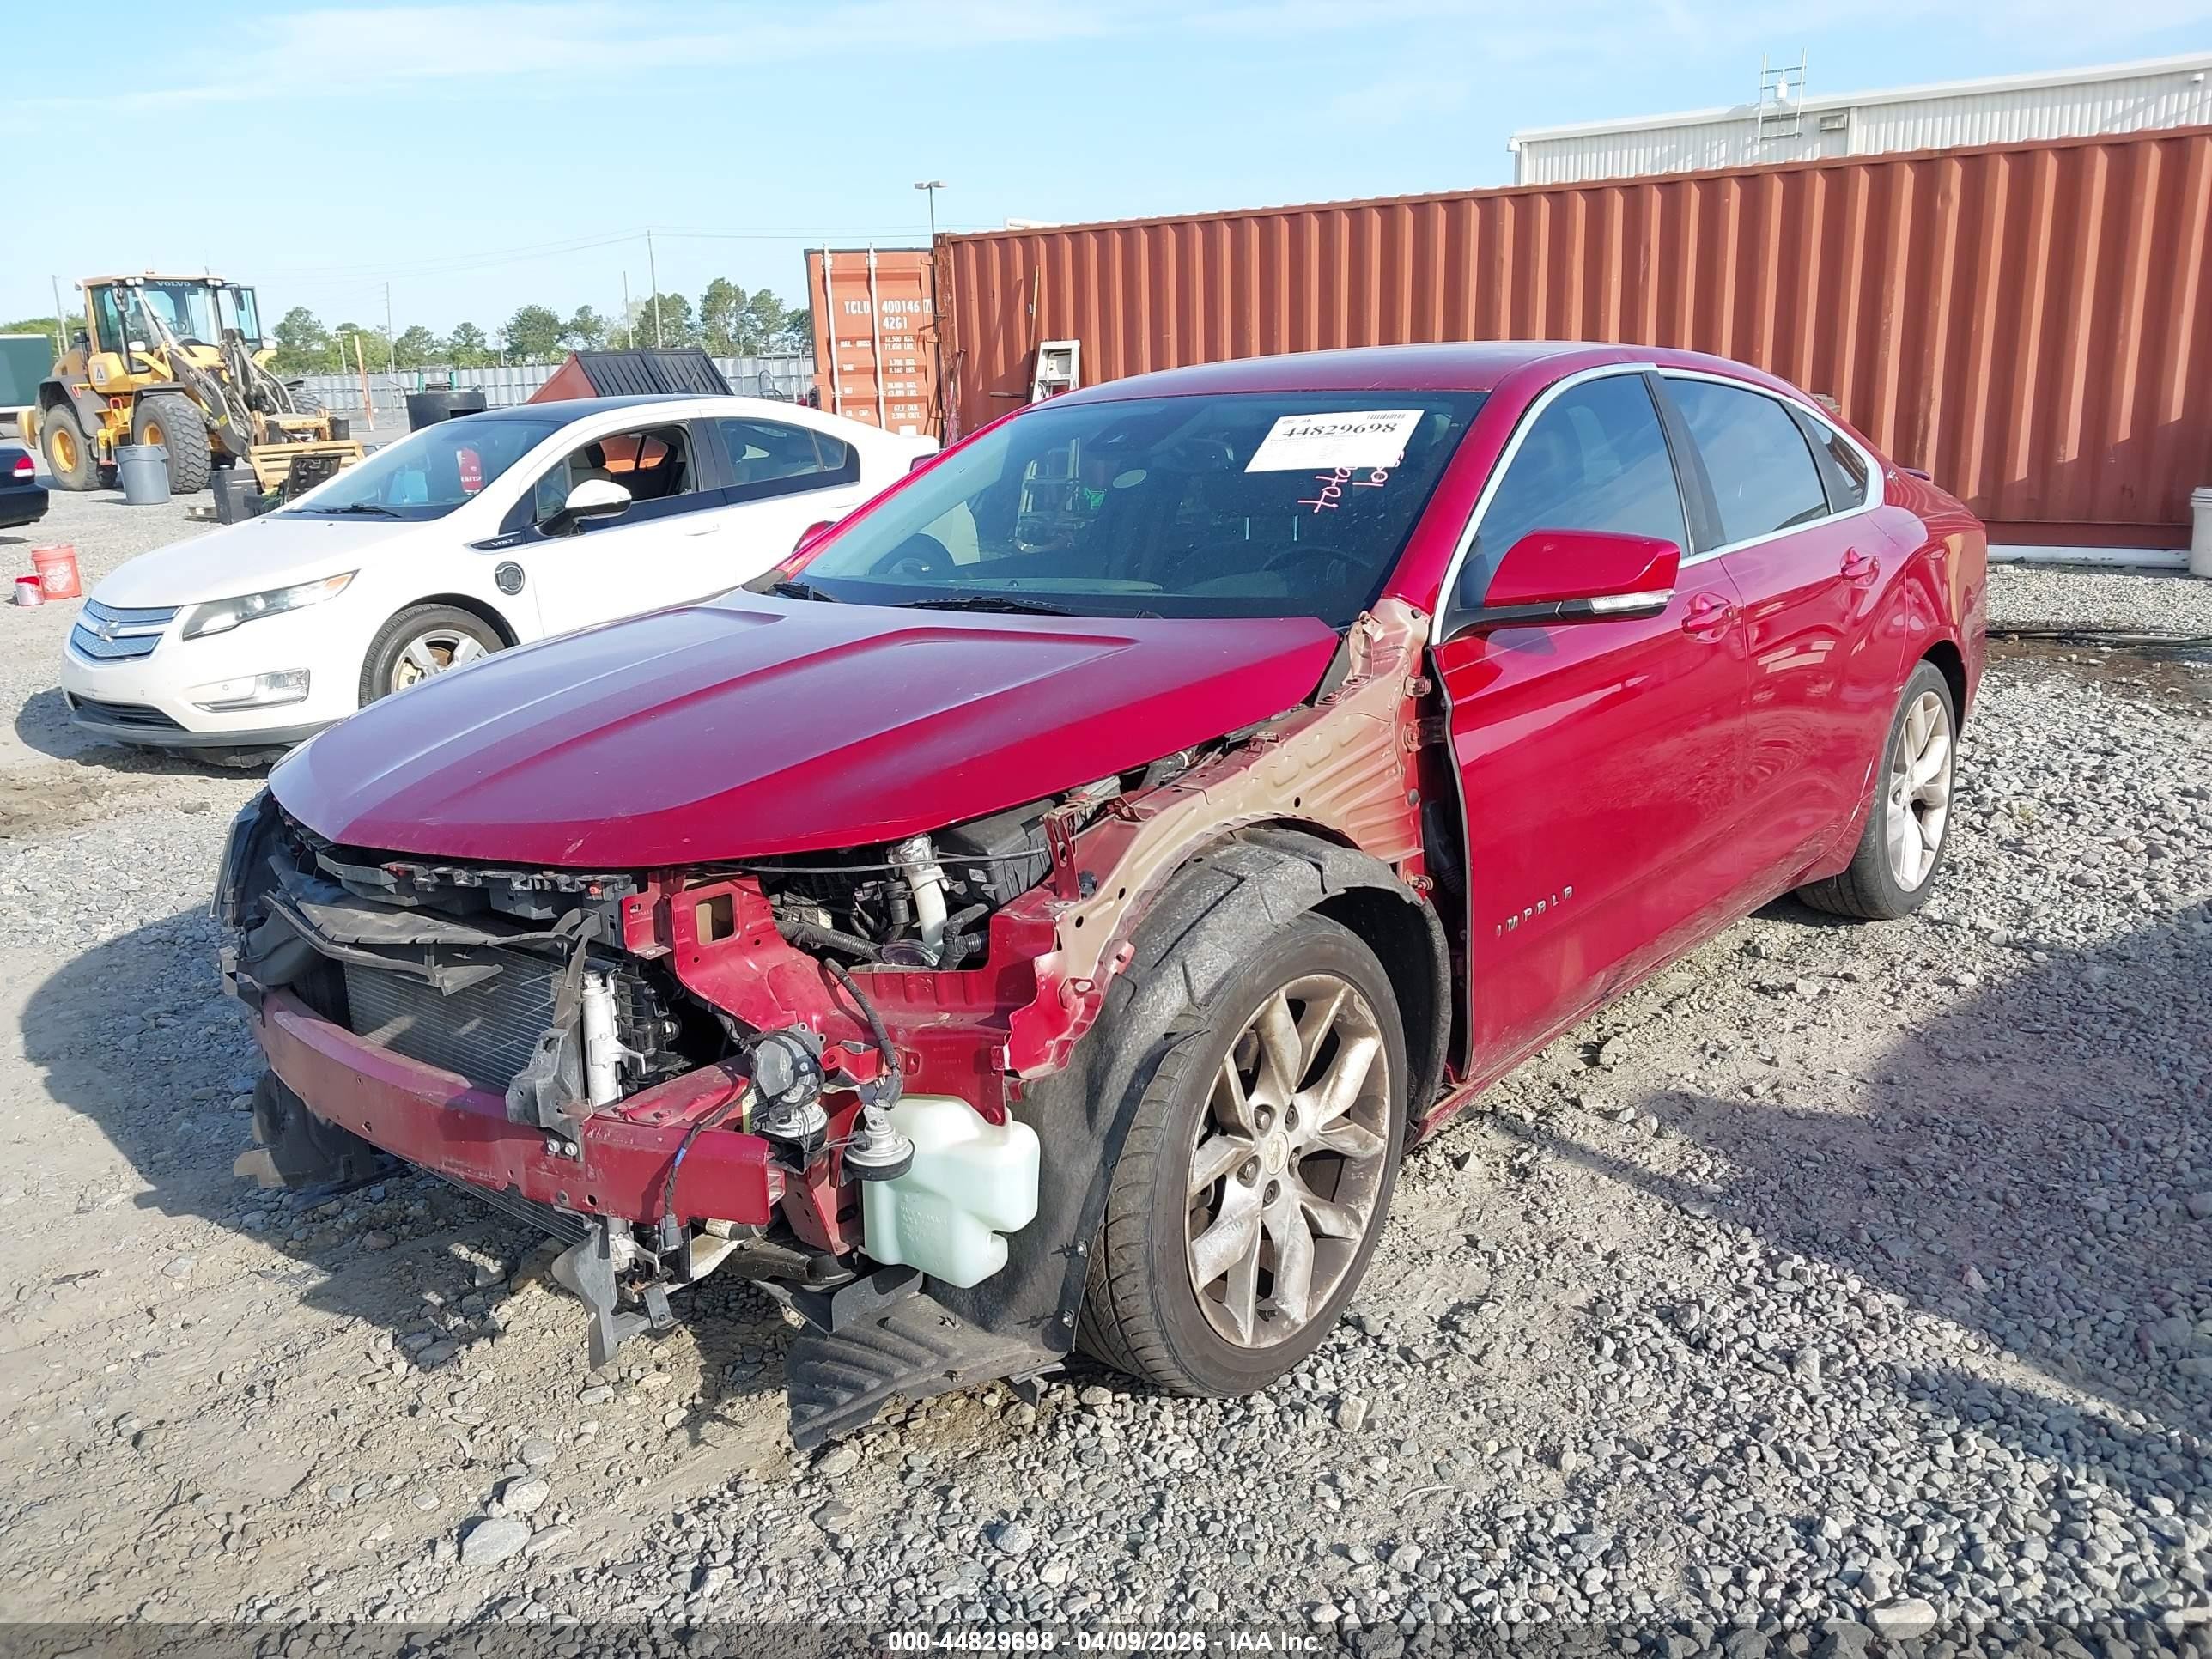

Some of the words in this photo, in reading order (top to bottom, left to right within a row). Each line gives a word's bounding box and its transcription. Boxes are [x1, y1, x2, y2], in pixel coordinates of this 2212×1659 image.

[844, 300, 870, 314] TCLU
[882, 299, 920, 313] 400146
[883, 316, 908, 330] 42G1
[1282, 422, 1399, 438] 44829698
[1496, 885, 1573, 938] IMPALA
